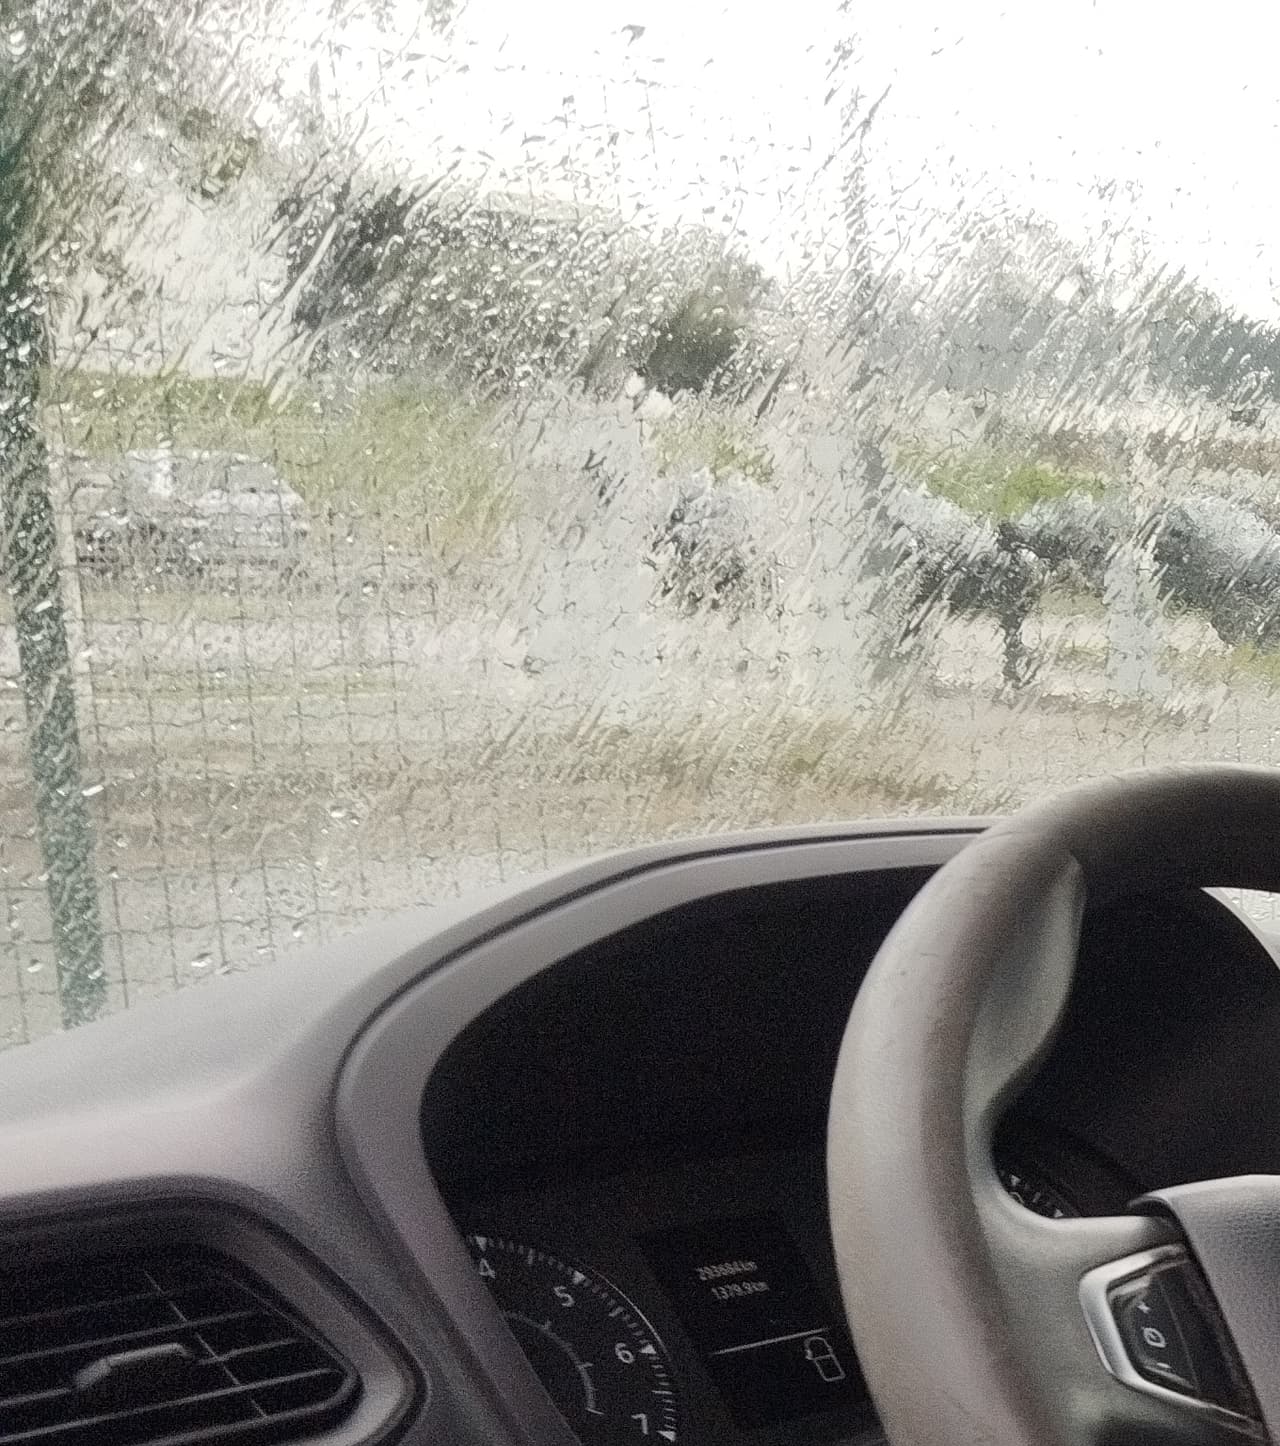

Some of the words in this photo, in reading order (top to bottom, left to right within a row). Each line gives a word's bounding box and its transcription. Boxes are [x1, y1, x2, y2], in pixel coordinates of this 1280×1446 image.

[479, 1259, 496, 1279] 4
[553, 1285, 575, 1307] 5
[614, 1342, 635, 1364] 6
[630, 1412, 649, 1436] 7
